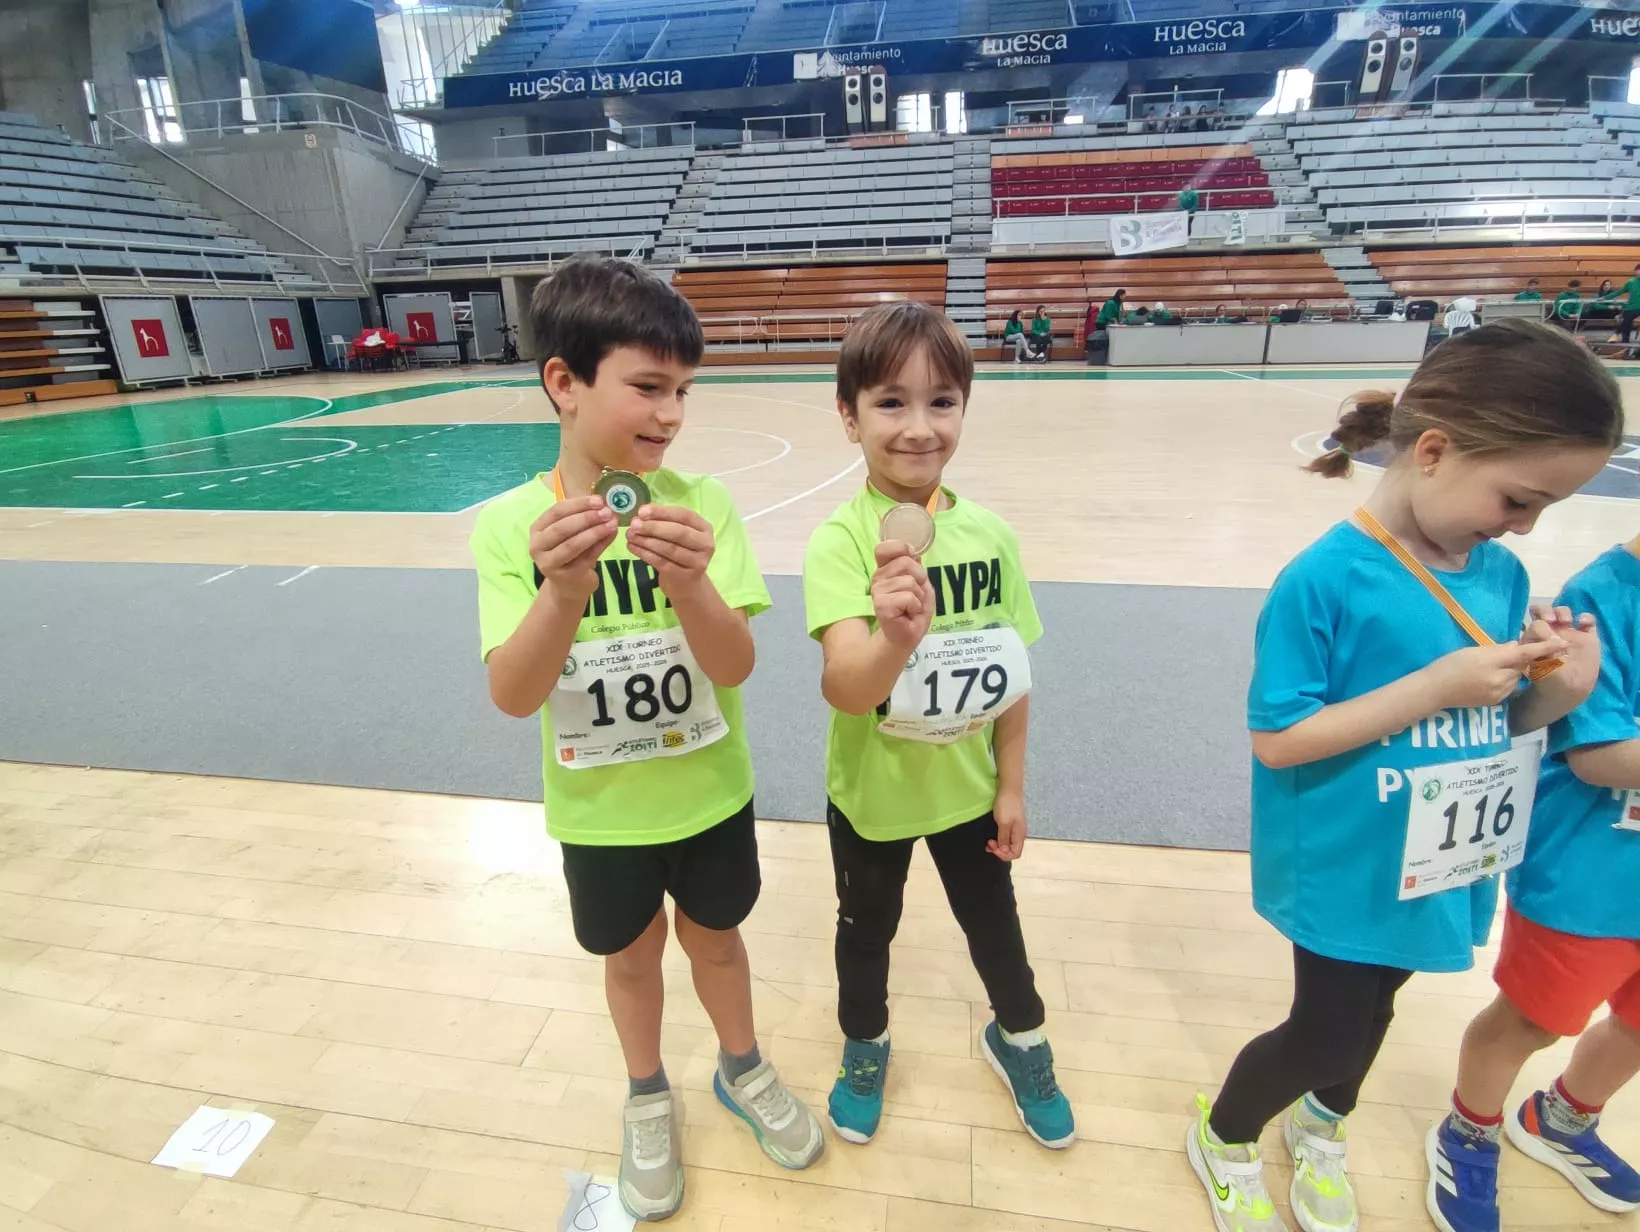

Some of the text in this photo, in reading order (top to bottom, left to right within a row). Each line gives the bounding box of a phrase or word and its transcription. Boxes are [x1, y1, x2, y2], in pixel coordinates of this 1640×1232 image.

[1154, 20, 1245, 42] Huesca
[1590, 17, 1640, 36] Hue
[982, 33, 1068, 55] Huesca
[509, 75, 586, 97] Huesca
[591, 624, 621, 635] Colegio
[957, 636, 984, 645] TORNEO
[583, 644, 682, 668] ATLETISMO DIVERTIDO
[606, 637, 662, 653] XIX TORNEO
[924, 644, 1003, 660] ATLETISMO DIVERTIDO
[587, 664, 692, 727] 180
[923, 663, 1008, 717] 179
[1446, 776, 1488, 791] ATLETISMO
[1438, 785, 1514, 851] 116
[192, 1118, 251, 1156] 10
[573, 1182, 612, 1231] 8
